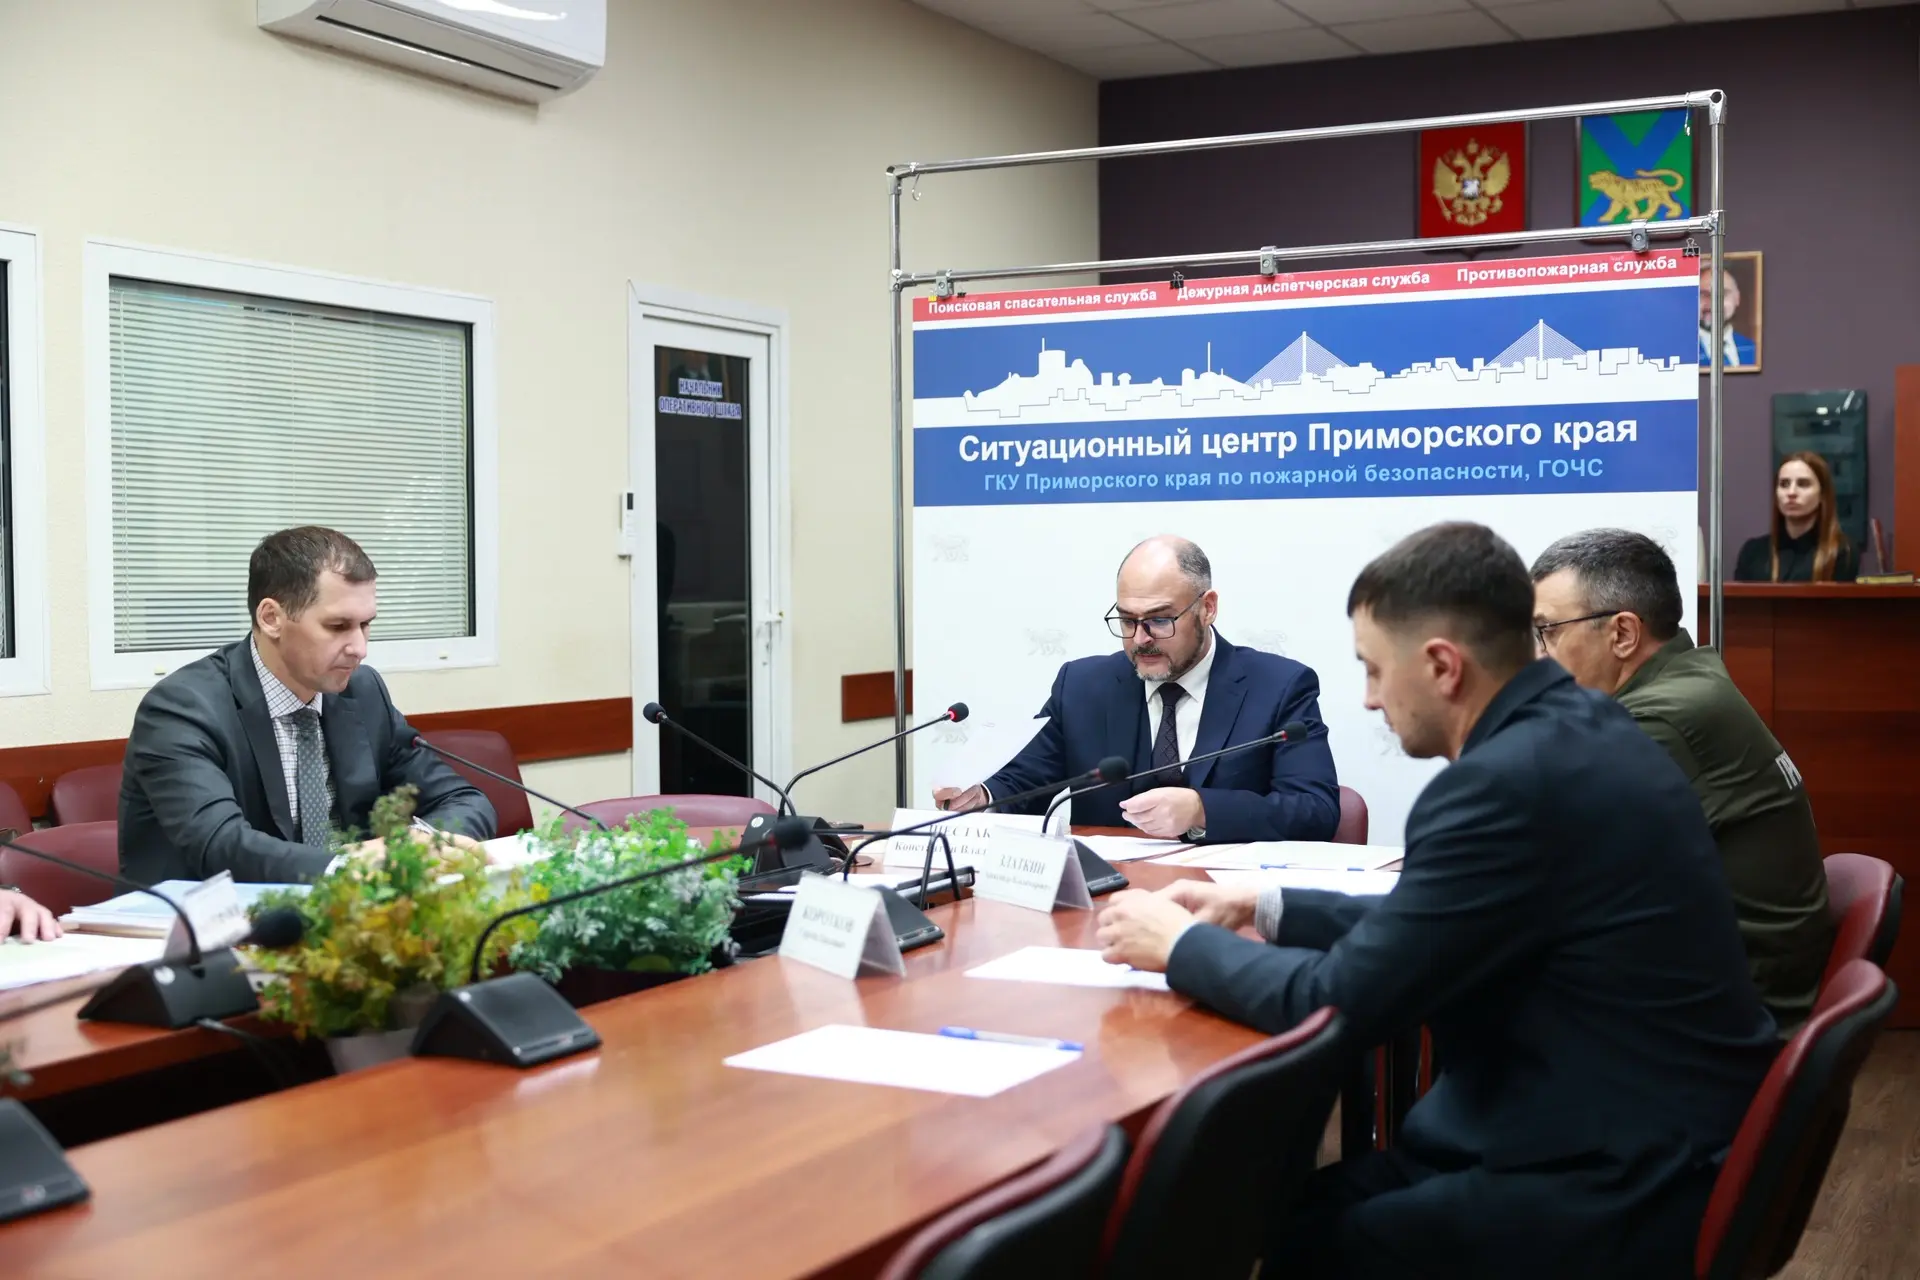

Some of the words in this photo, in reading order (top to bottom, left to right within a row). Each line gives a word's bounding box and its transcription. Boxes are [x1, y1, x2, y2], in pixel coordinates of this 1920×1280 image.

[1456, 262, 1609, 283] Противопожарная
[1613, 256, 1677, 274] служба
[1177, 282, 1250, 301] Дежурная
[1252, 277, 1368, 296] диспетчерская
[1372, 271, 1431, 289] служба
[928, 299, 1001, 314] Поисковая
[1004, 294, 1101, 311] спасательная
[1104, 289, 1157, 305] служба
[959, 428, 1192, 466] Ситуационный
[1202, 430, 1297, 458] центр
[1308, 423, 1542, 456] Приморского
[1553, 419, 1638, 450] края
[984, 473, 1019, 491] ГКУ
[1026, 472, 1159, 493] Приморского
[1165, 471, 1211, 490] края
[1219, 471, 1243, 487] по
[1249, 463, 1358, 486] пожарной
[1365, 461, 1530, 483] безопасности,
[1538, 459, 1604, 478] ГОЧС
